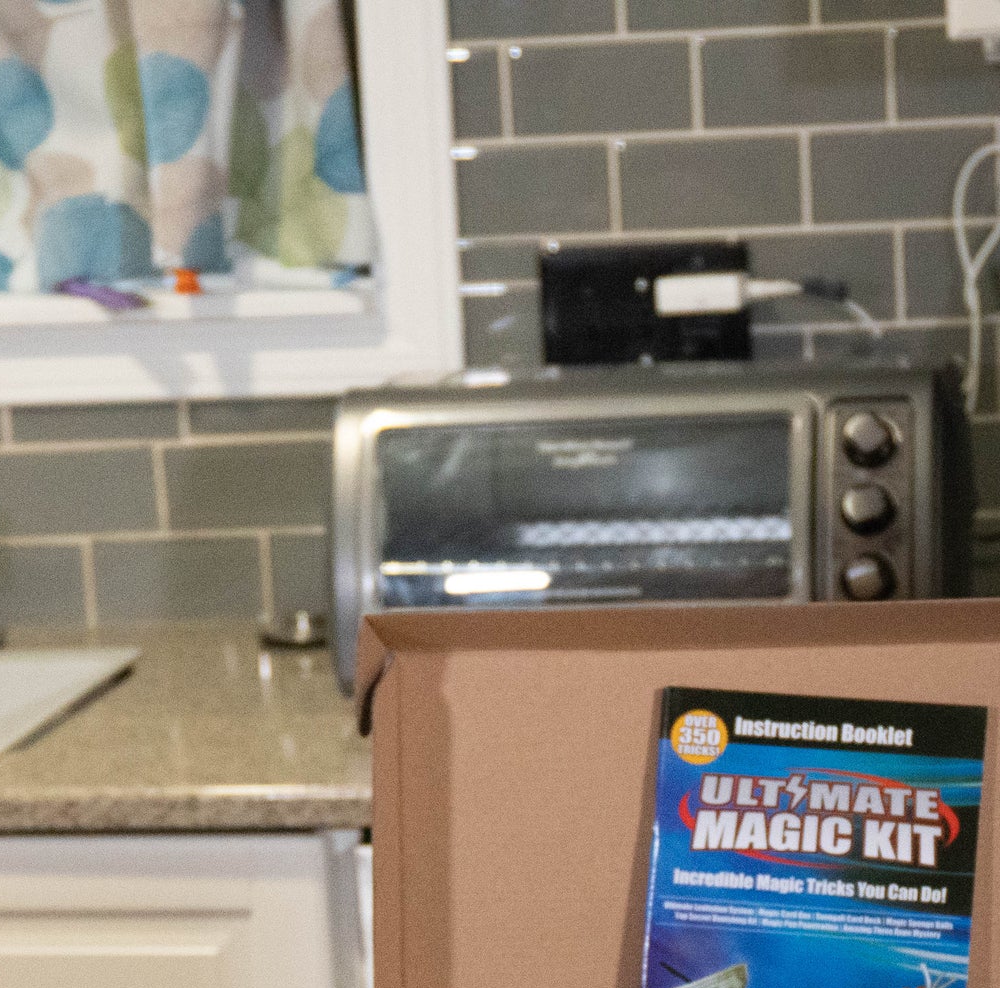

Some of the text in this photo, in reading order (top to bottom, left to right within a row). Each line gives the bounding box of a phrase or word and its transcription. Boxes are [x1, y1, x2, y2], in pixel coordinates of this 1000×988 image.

[678, 728, 722, 746] 350
[684, 714, 718, 729] OVER
[734, 716, 914, 747] Instruction Booklet
[676, 743, 722, 757] TRICKS!
[700, 773, 942, 821] ULTIMATE
[692, 809, 943, 868] MAGIC KIT
[672, 868, 949, 905] Incredible Magic Tricks You Can Do!
